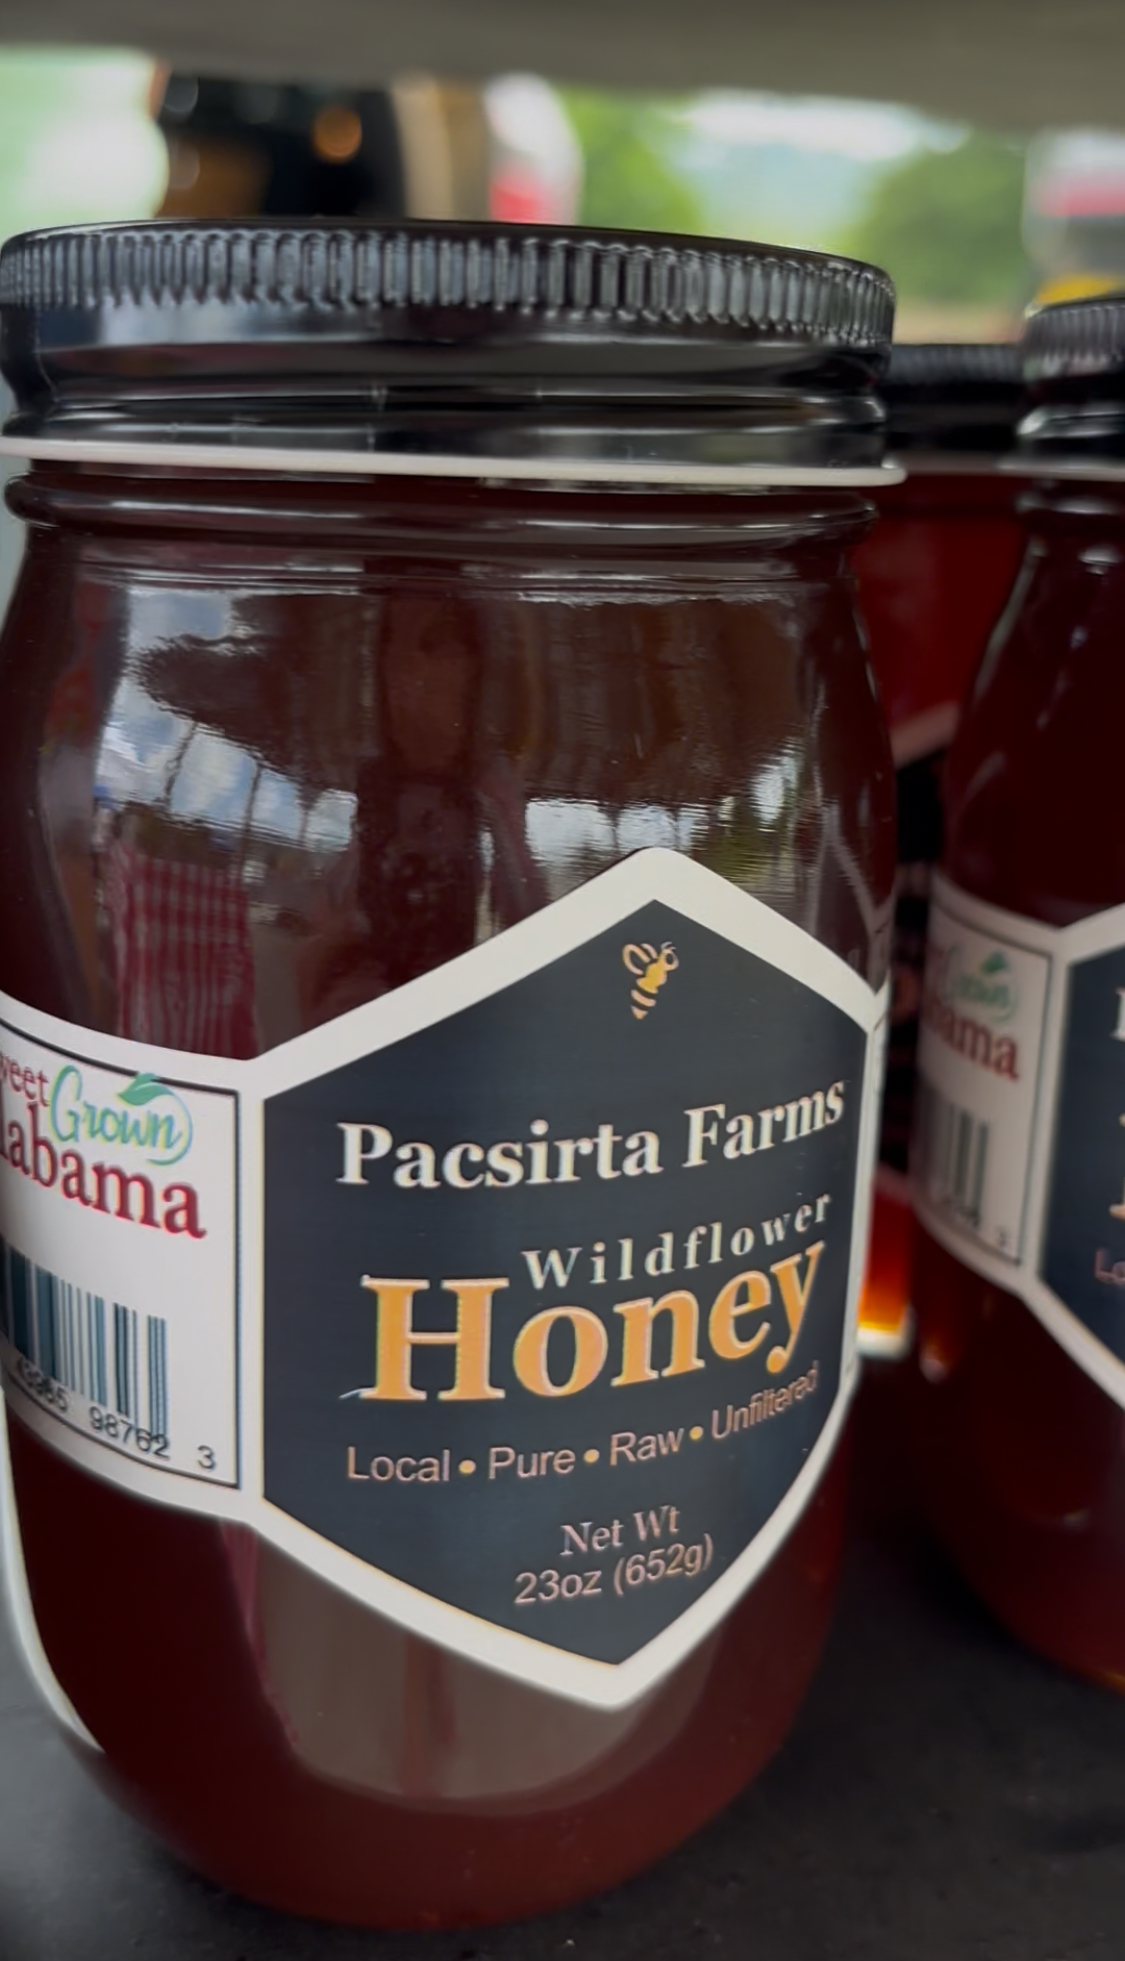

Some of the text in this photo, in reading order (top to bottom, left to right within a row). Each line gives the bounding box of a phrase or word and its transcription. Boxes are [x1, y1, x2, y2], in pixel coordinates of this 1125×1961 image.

[50, 1065, 184, 1151] Grown
[336, 1081, 845, 1188] Pacsirta Farms
[521, 1194, 831, 1290] Wildflower
[358, 1241, 826, 1402] Honey
[197, 1445, 216, 1470] 3
[347, 1361, 818, 1483] Local Pure Raw Unfiltered
[514, 1533, 714, 1605] 23oz (652g)
[560, 1504, 680, 1556] Net Wt
